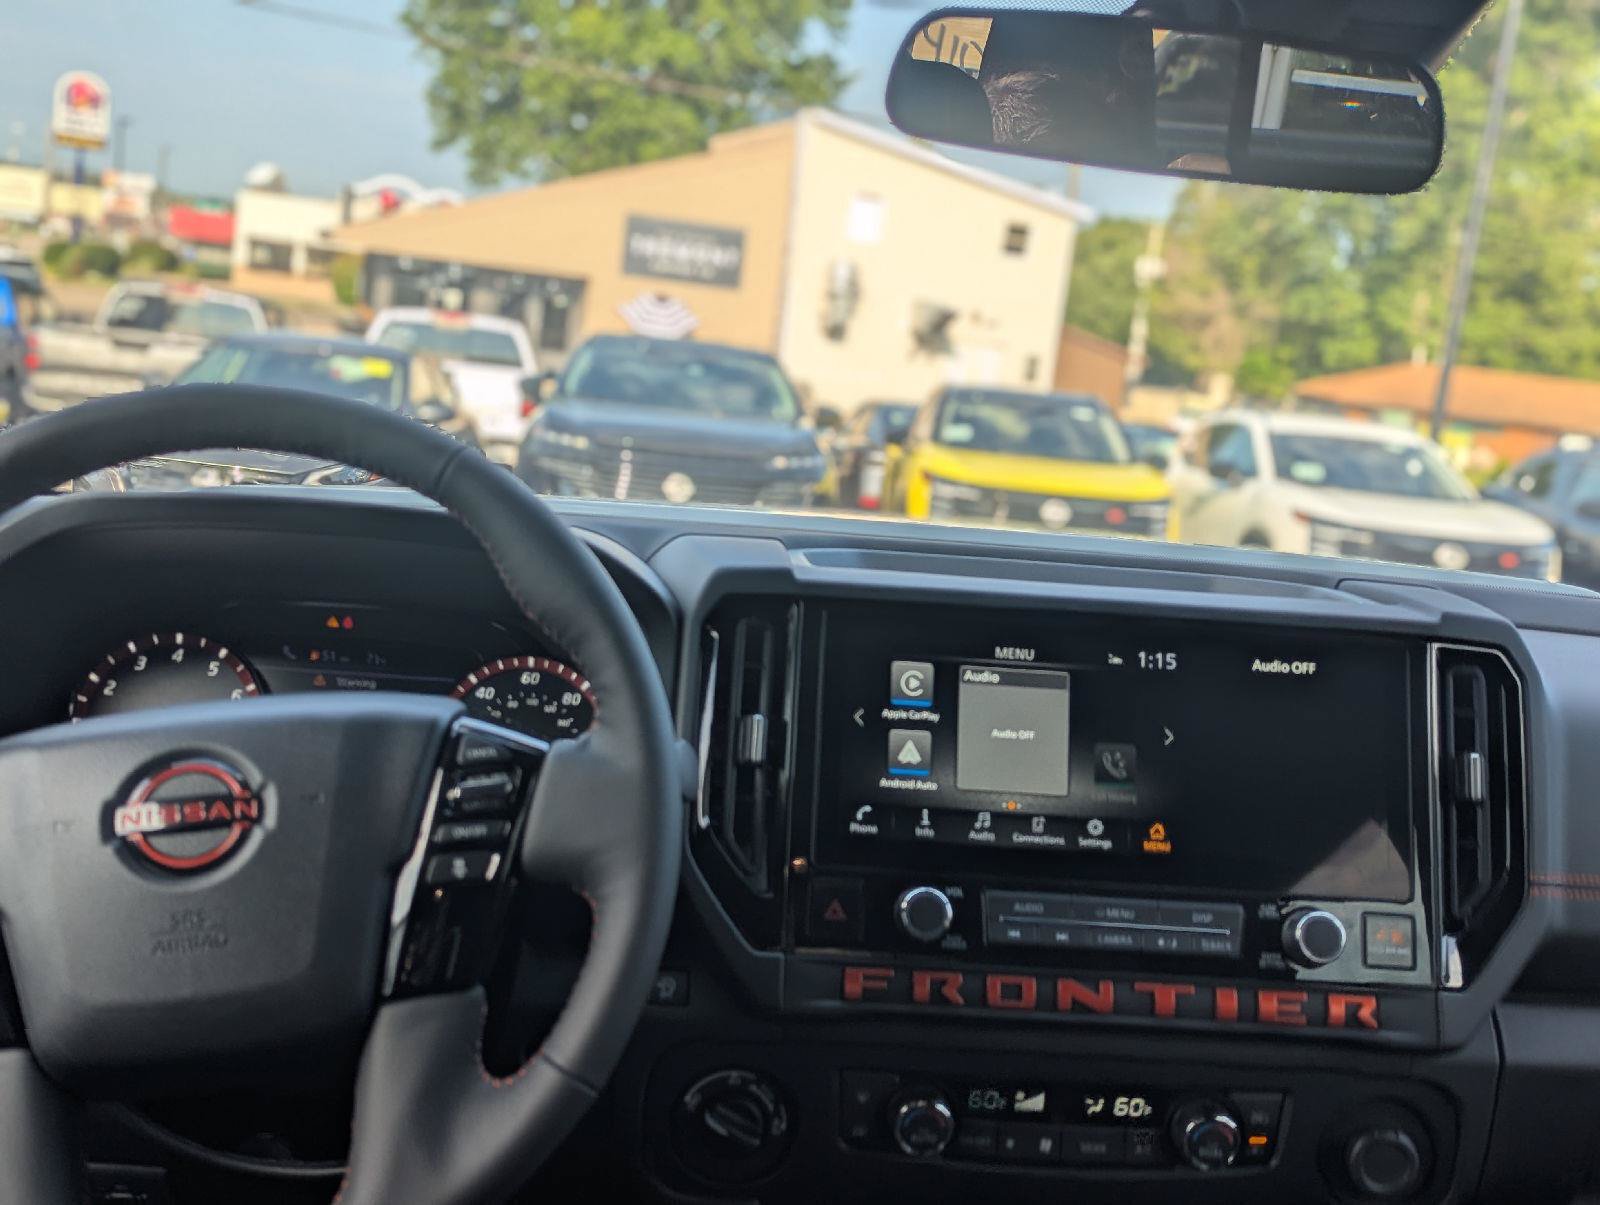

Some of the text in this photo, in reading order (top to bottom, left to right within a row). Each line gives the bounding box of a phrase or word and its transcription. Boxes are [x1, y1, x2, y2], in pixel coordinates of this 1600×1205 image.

[170, 648, 185, 664] 4
[994, 646, 1036, 661] MENU
[1137, 650, 1178, 671] 1:15
[133, 655, 148, 672] 3
[207, 660, 221, 677] 5
[1251, 658, 1290, 674] Audio
[962, 669, 1000, 684] Audio
[102, 678, 118, 697] 2
[474, 686, 496, 701] 40
[121, 798, 260, 831] NISSAN
[842, 965, 1380, 1030] FRONTIER
